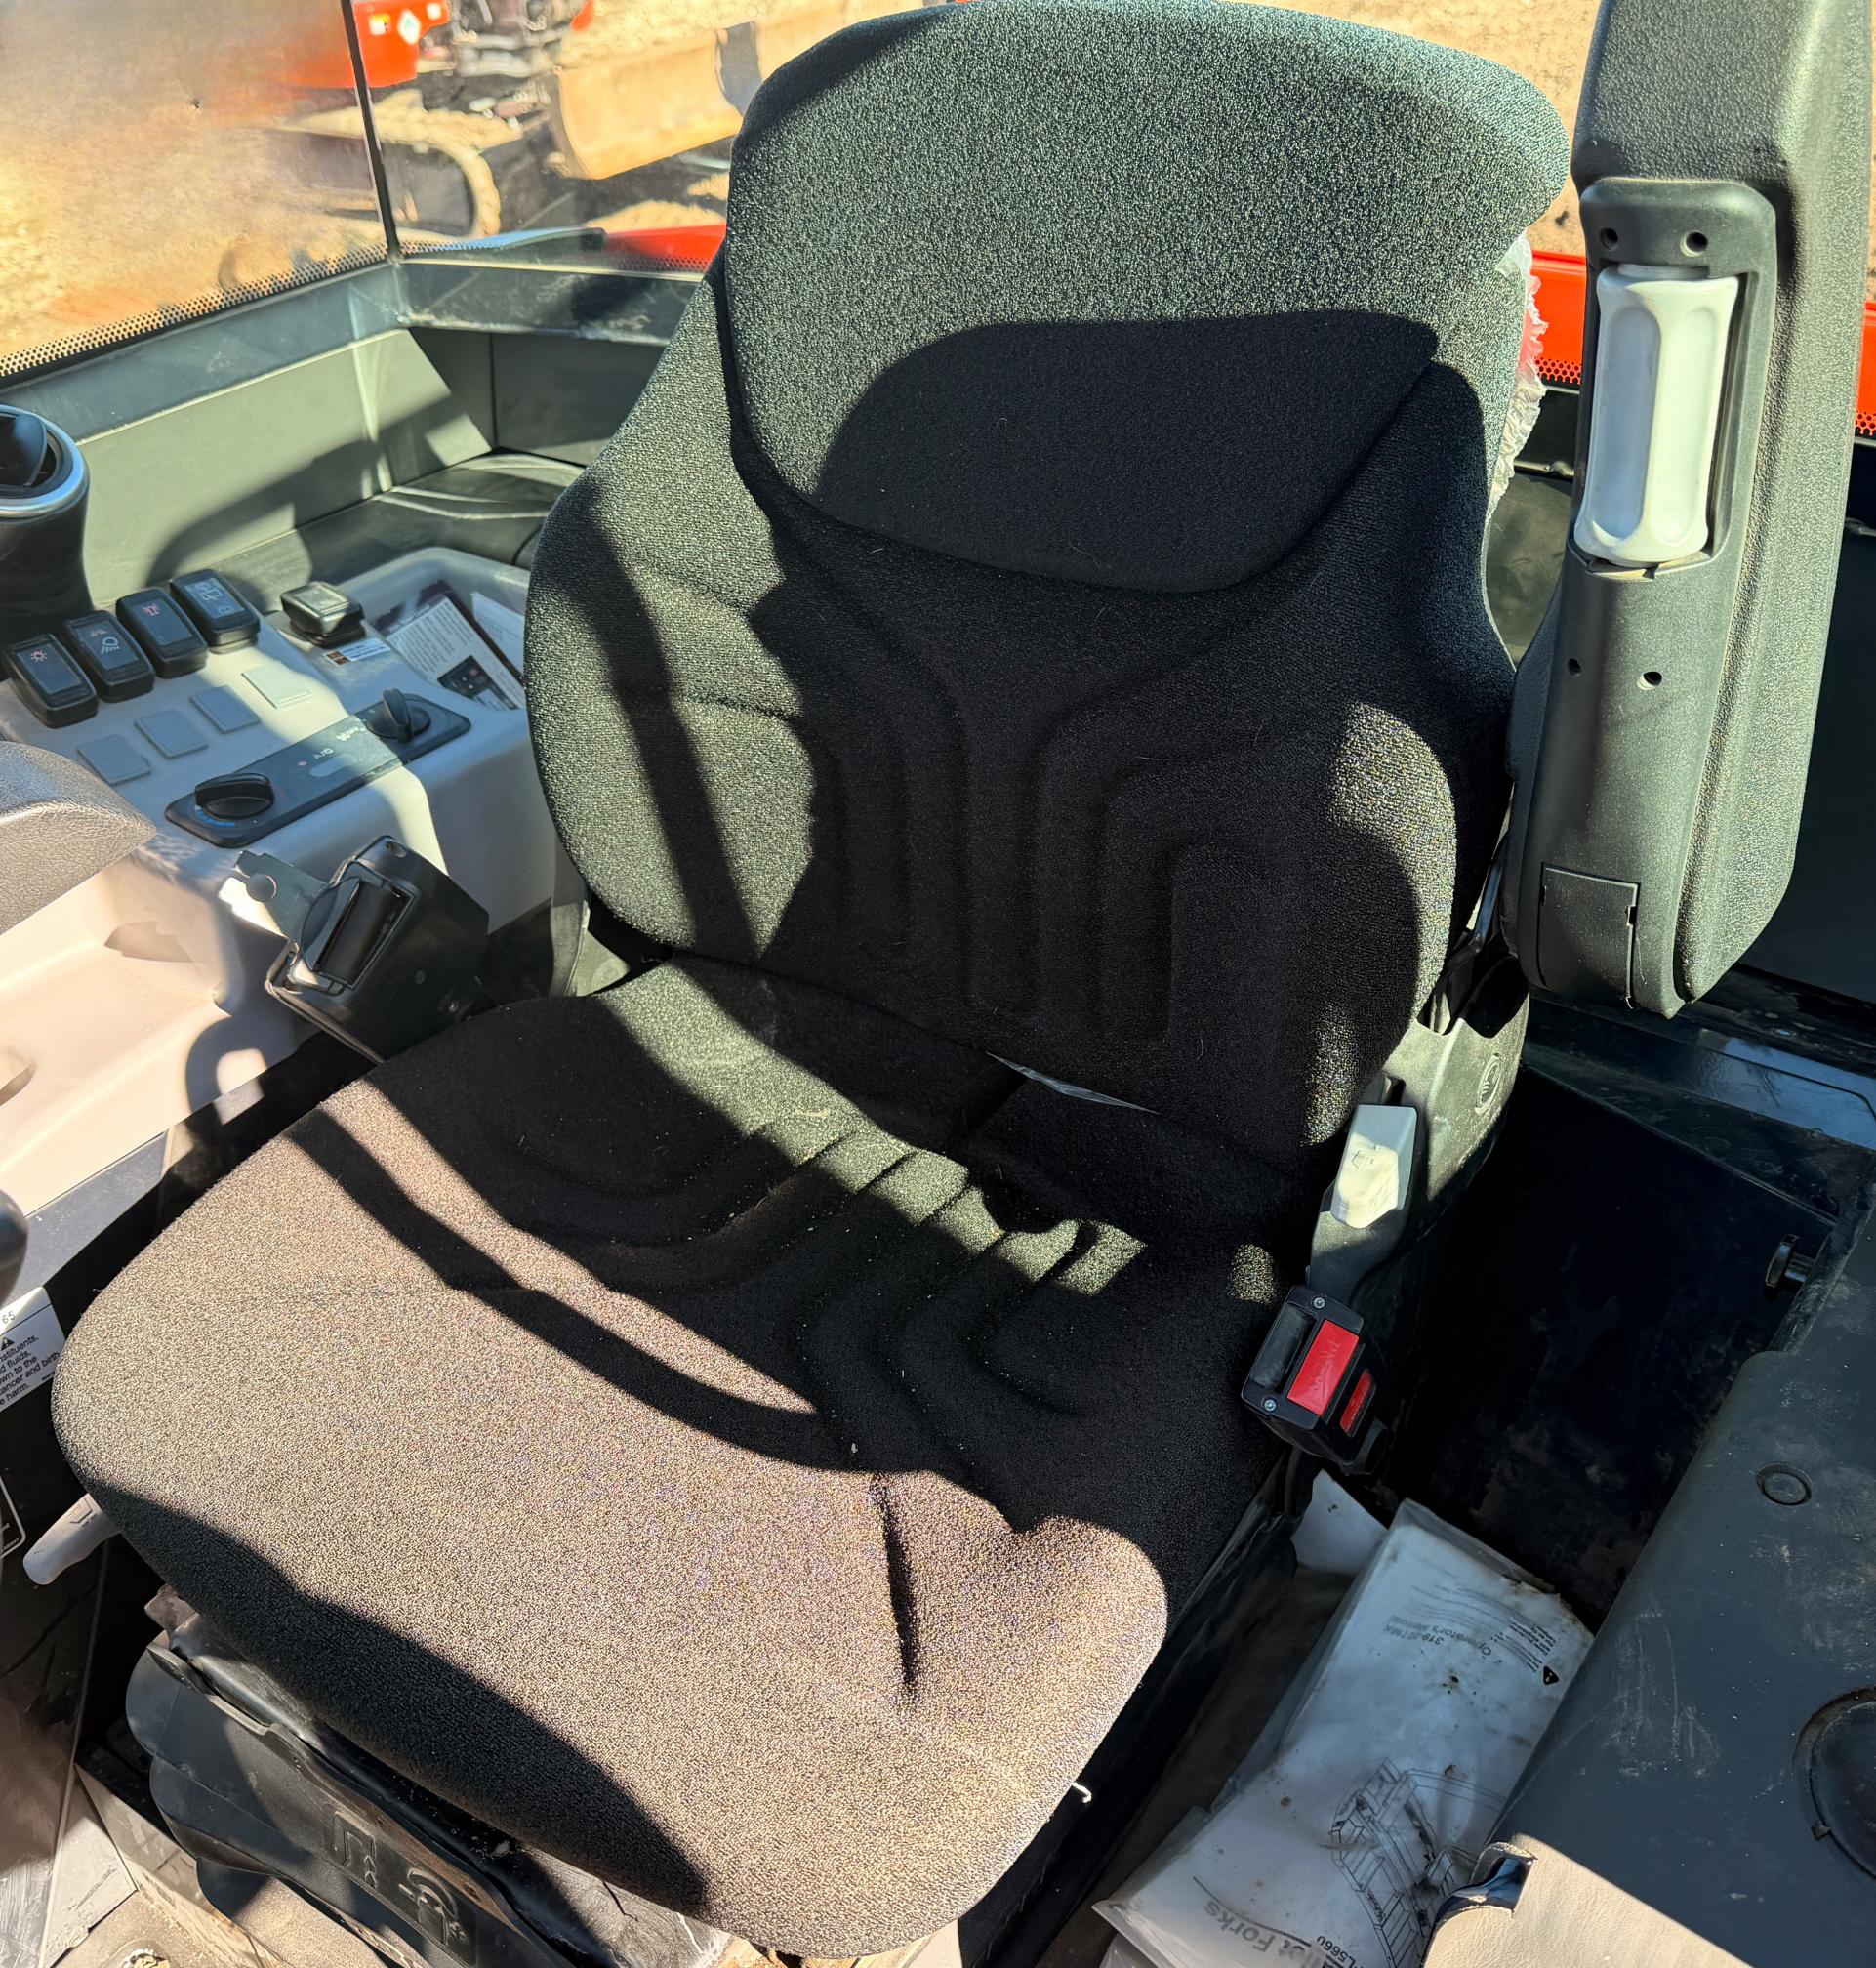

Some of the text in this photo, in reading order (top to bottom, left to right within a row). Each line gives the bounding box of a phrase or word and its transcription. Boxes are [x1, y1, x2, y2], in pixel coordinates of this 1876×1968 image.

[313, 747, 334, 759] A/C
[2, 1311, 16, 1325] 65
[7, 1350, 32, 1369] fluids,
[14, 1365, 22, 1375] to
[23, 1355, 38, 1369] the
[25, 1363, 41, 1378] and
[41, 1351, 60, 1368] birth
[6, 1382, 30, 1401] harm.
[1204, 1900, 1276, 1953] Forks
